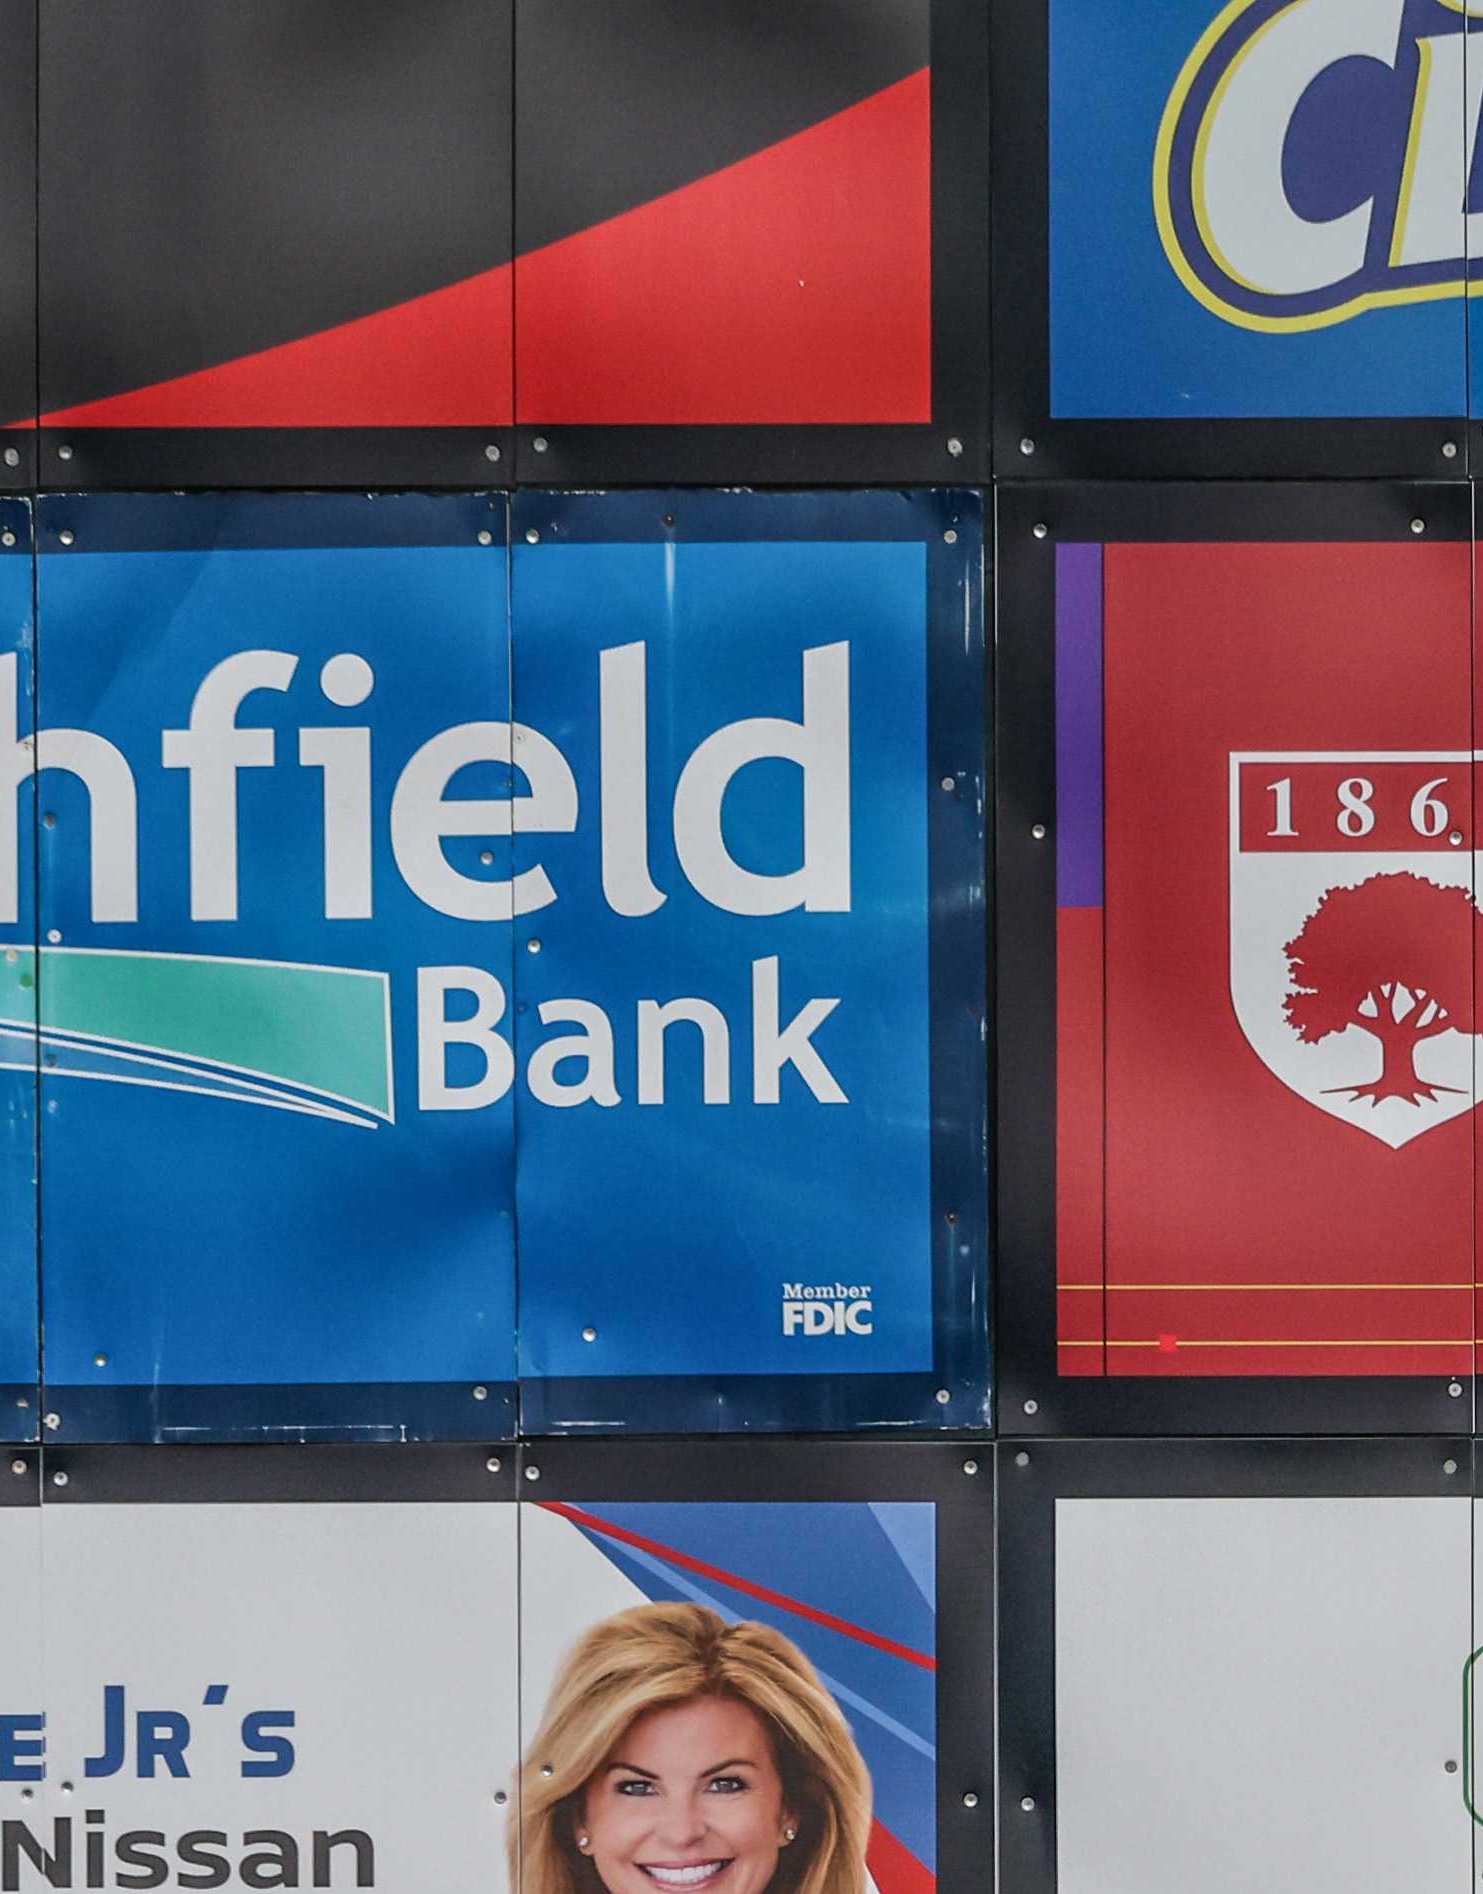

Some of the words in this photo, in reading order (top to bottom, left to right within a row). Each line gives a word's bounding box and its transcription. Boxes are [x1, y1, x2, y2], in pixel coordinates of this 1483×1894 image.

[417, 956, 849, 1110] Bank
[783, 1283, 871, 1299] Member
[783, 1301, 872, 1335] FDIC
[2, 1809, 374, 1891] Nissan
